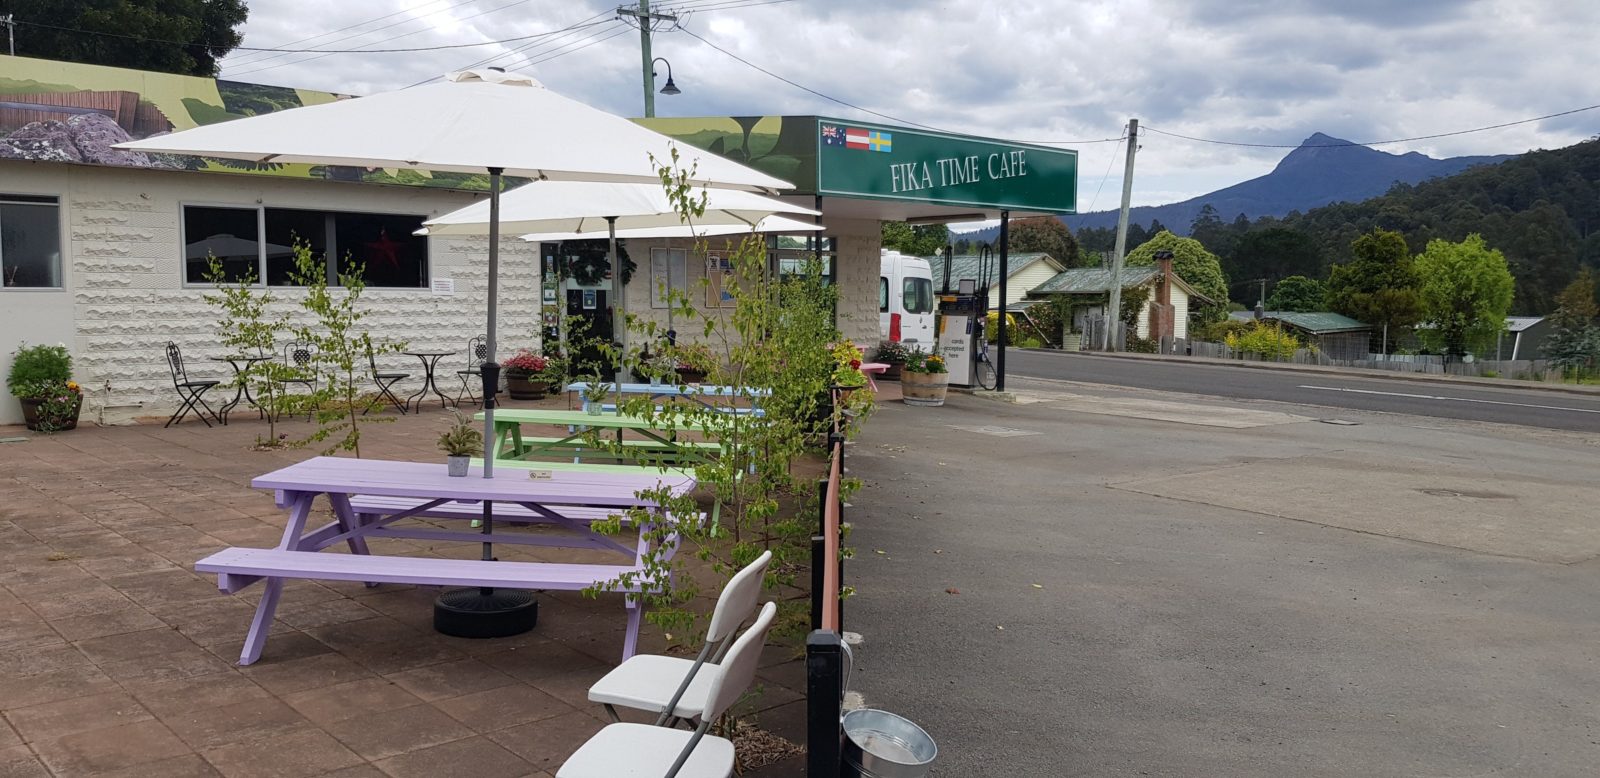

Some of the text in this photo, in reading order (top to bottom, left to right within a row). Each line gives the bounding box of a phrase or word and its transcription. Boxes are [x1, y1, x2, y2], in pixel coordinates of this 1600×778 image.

[889, 150, 1027, 193] FIKA TIME CAFE
